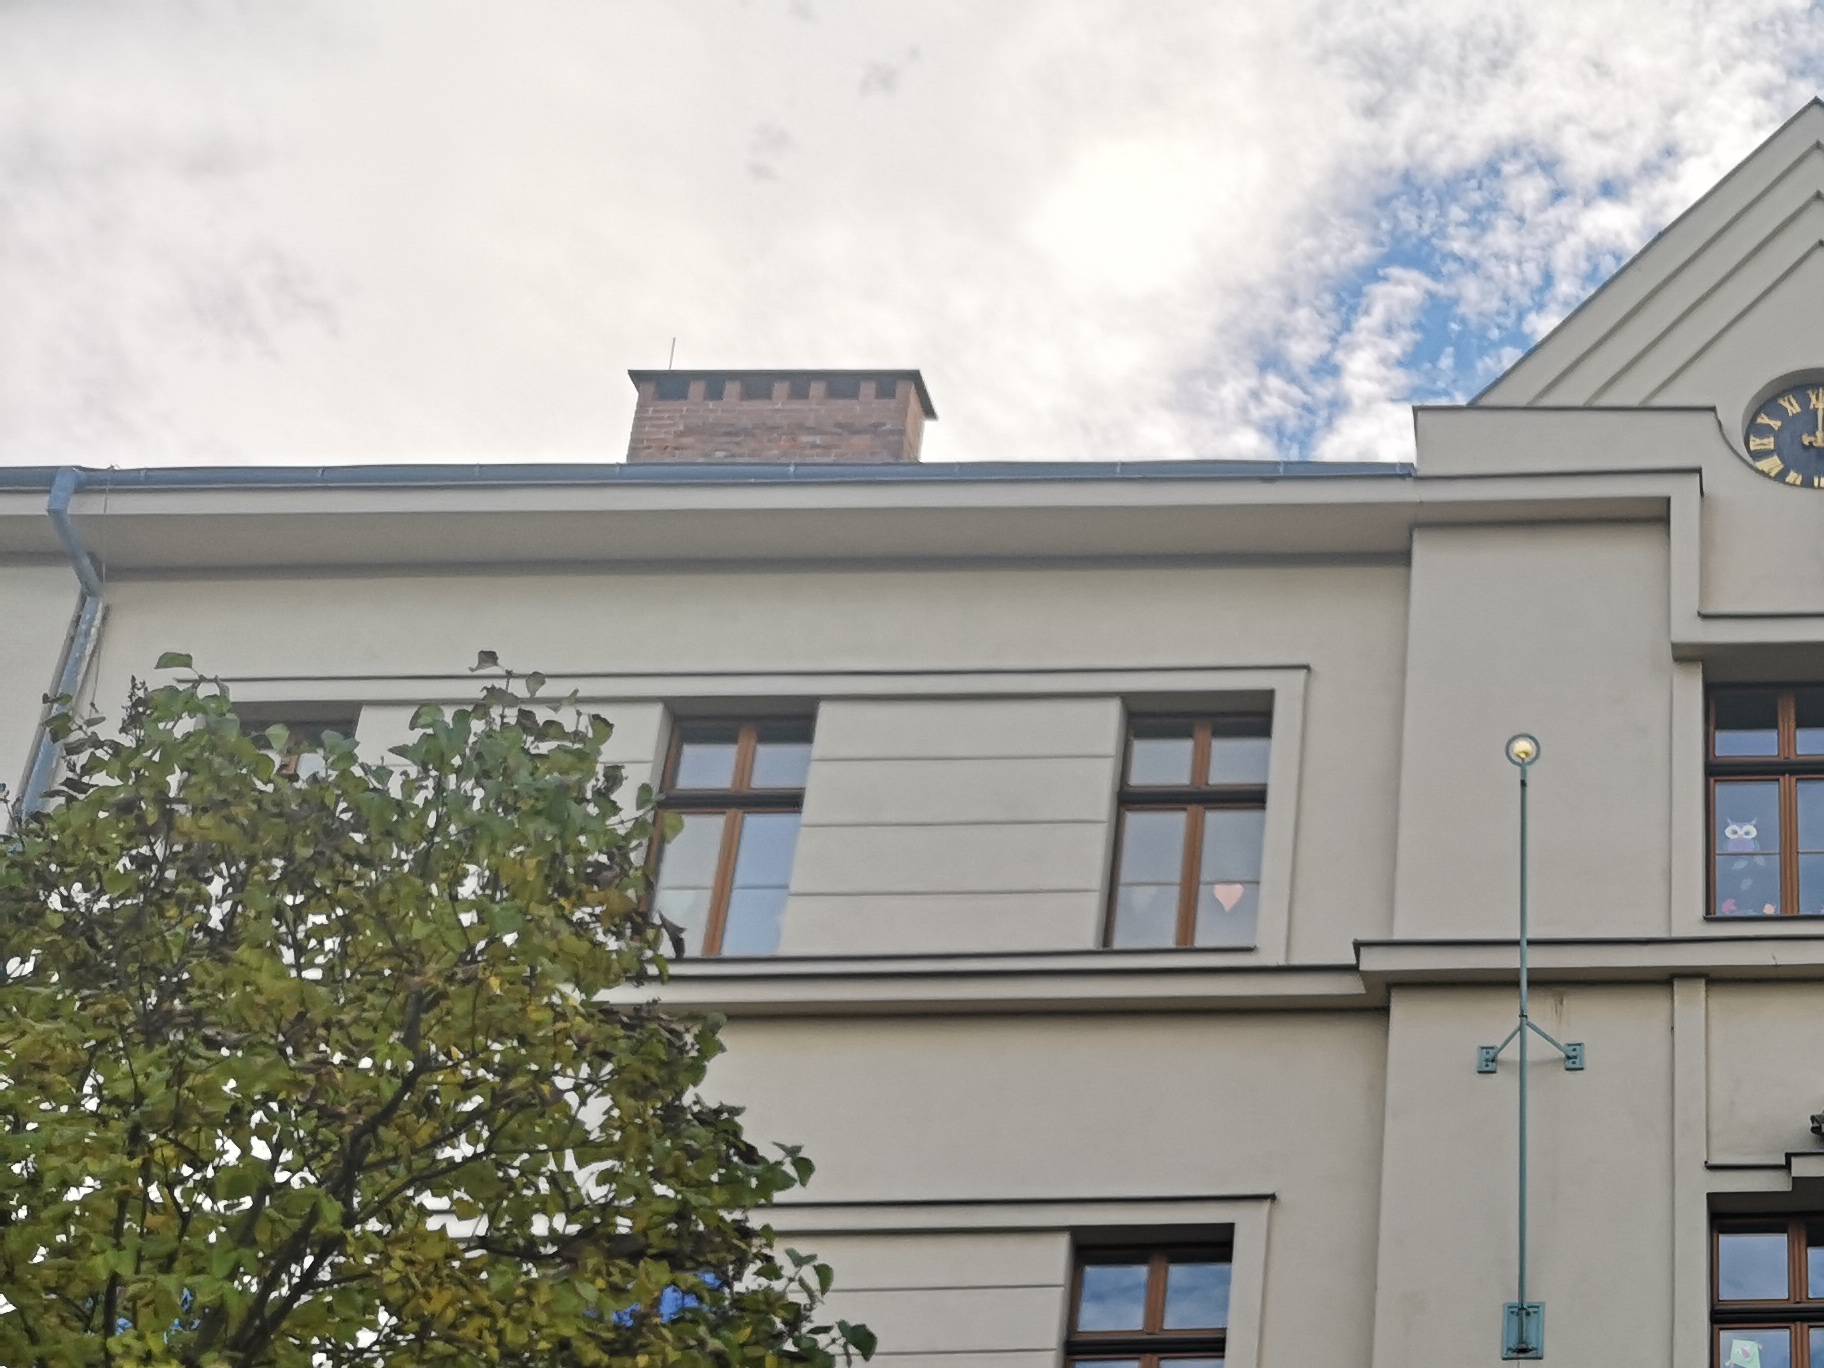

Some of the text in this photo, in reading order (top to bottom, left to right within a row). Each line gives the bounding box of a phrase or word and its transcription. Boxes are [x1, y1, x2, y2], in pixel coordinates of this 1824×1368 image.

[1777, 395, 1801, 416] XI
[1757, 413, 1782, 430] X
[1750, 436, 1774, 451] IX
